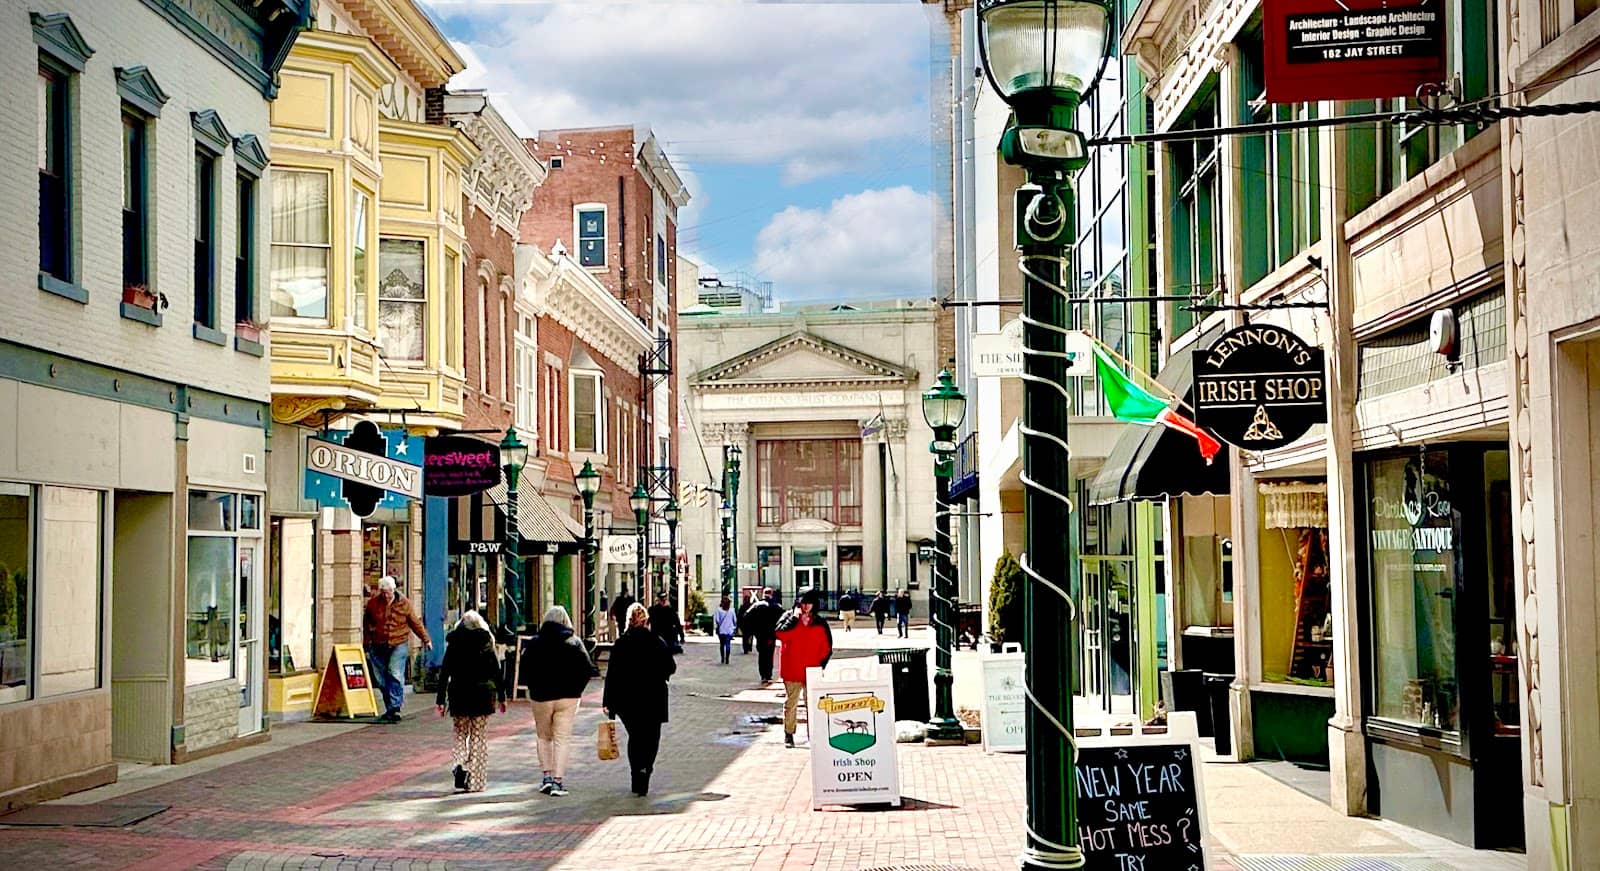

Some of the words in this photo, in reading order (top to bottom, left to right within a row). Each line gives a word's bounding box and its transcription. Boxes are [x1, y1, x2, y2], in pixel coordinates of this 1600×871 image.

[1289, 19, 1338, 30] Architecture
[1344, 15, 1387, 27] Landscape
[1388, 11, 1436, 23] Architecture
[1301, 30, 1331, 42] Interior
[1333, 28, 1360, 40] Design
[1366, 26, 1397, 38] Graphic
[1398, 24, 1426, 36] Design
[1344, 47, 1364, 58] JAY
[1366, 44, 1404, 56] STREET
[1207, 328, 1312, 368] LENNON'S
[1199, 379, 1257, 402] IRISH
[1264, 377, 1322, 400] SHOP
[425, 450, 492, 466] ersweet
[311, 446, 418, 491] ORION
[469, 542, 501, 553] raw
[1372, 530, 1408, 550] VINTAGE
[1414, 527, 1453, 554] ANTIQUE
[833, 759, 852, 767] Irish
[854, 758, 876, 768] Shop
[837, 771, 873, 782] OPEN
[1075, 765, 1120, 798] NEW
[1127, 763, 1186, 794] YEAR
[1104, 800, 1152, 822] SAME
[1078, 825, 1116, 853] HOT
[1127, 822, 1172, 848] MESS
[1115, 853, 1147, 871] TRY
